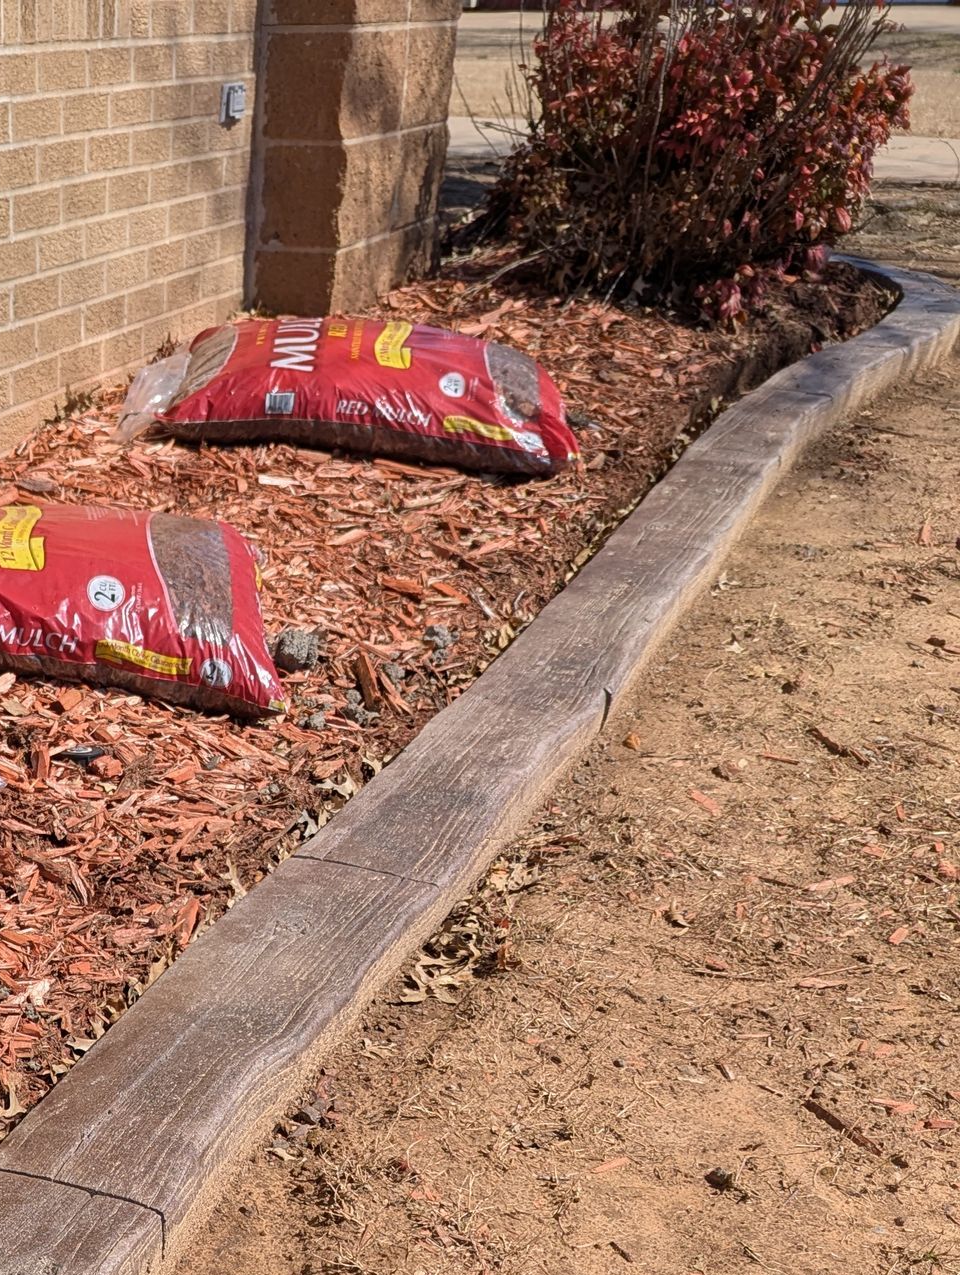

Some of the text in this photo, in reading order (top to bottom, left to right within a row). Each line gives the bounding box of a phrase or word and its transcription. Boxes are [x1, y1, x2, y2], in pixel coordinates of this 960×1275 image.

[270, 317, 323, 372] MUL
[336, 400, 369, 416] RED
[0, 550, 16, 562] 12
[99, 581, 107, 591] CU
[94, 591, 116, 603] 2
